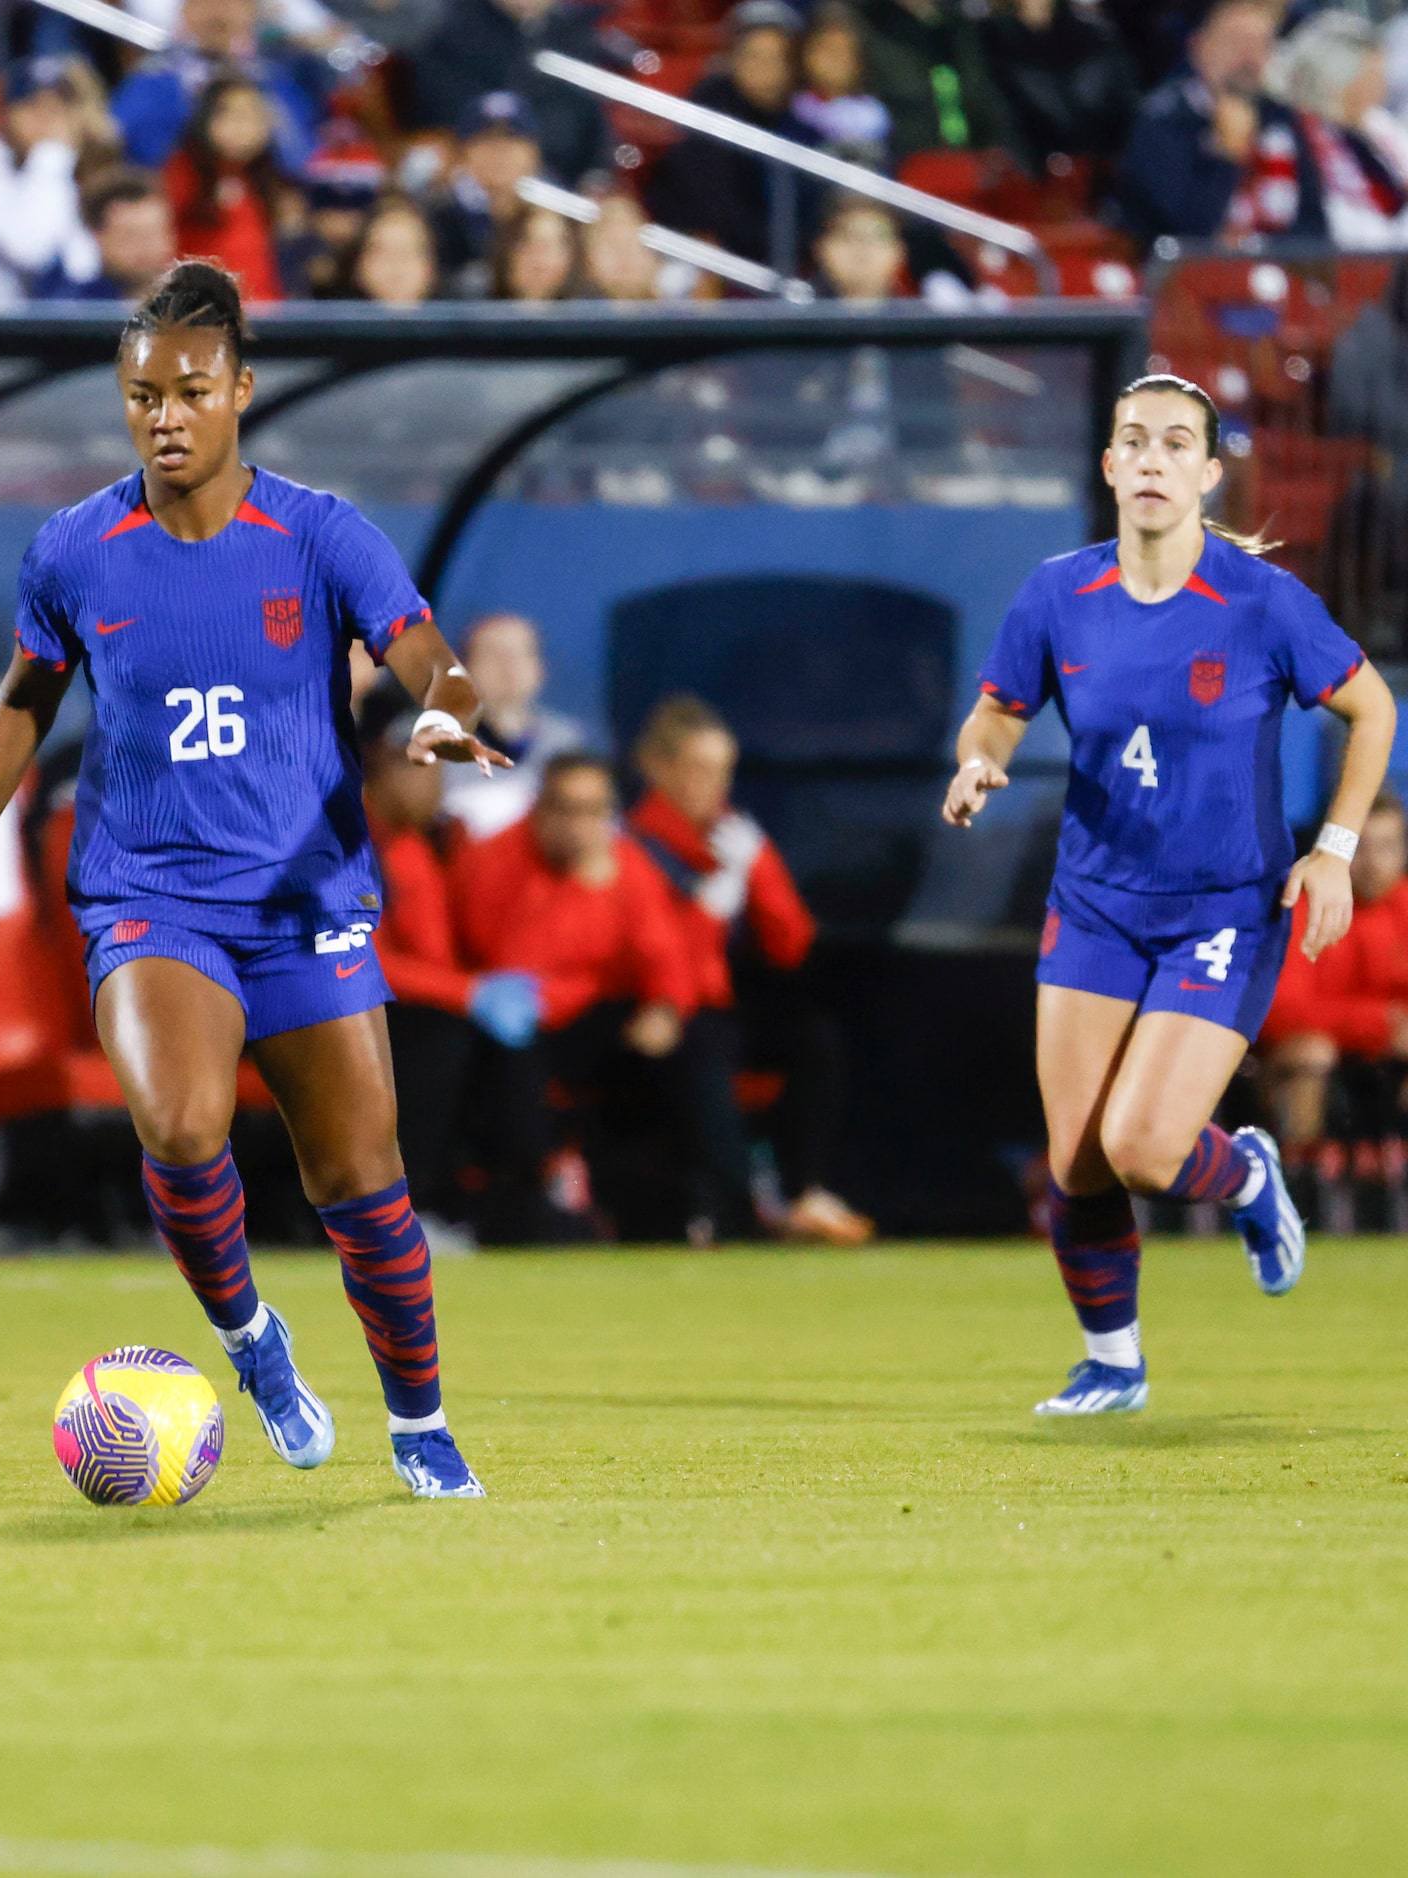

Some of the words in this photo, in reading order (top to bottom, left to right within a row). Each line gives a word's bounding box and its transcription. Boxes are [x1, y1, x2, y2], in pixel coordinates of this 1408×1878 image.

[165, 684, 247, 762] 26
[1121, 724, 1159, 788] 4
[1194, 927, 1237, 982] 4
